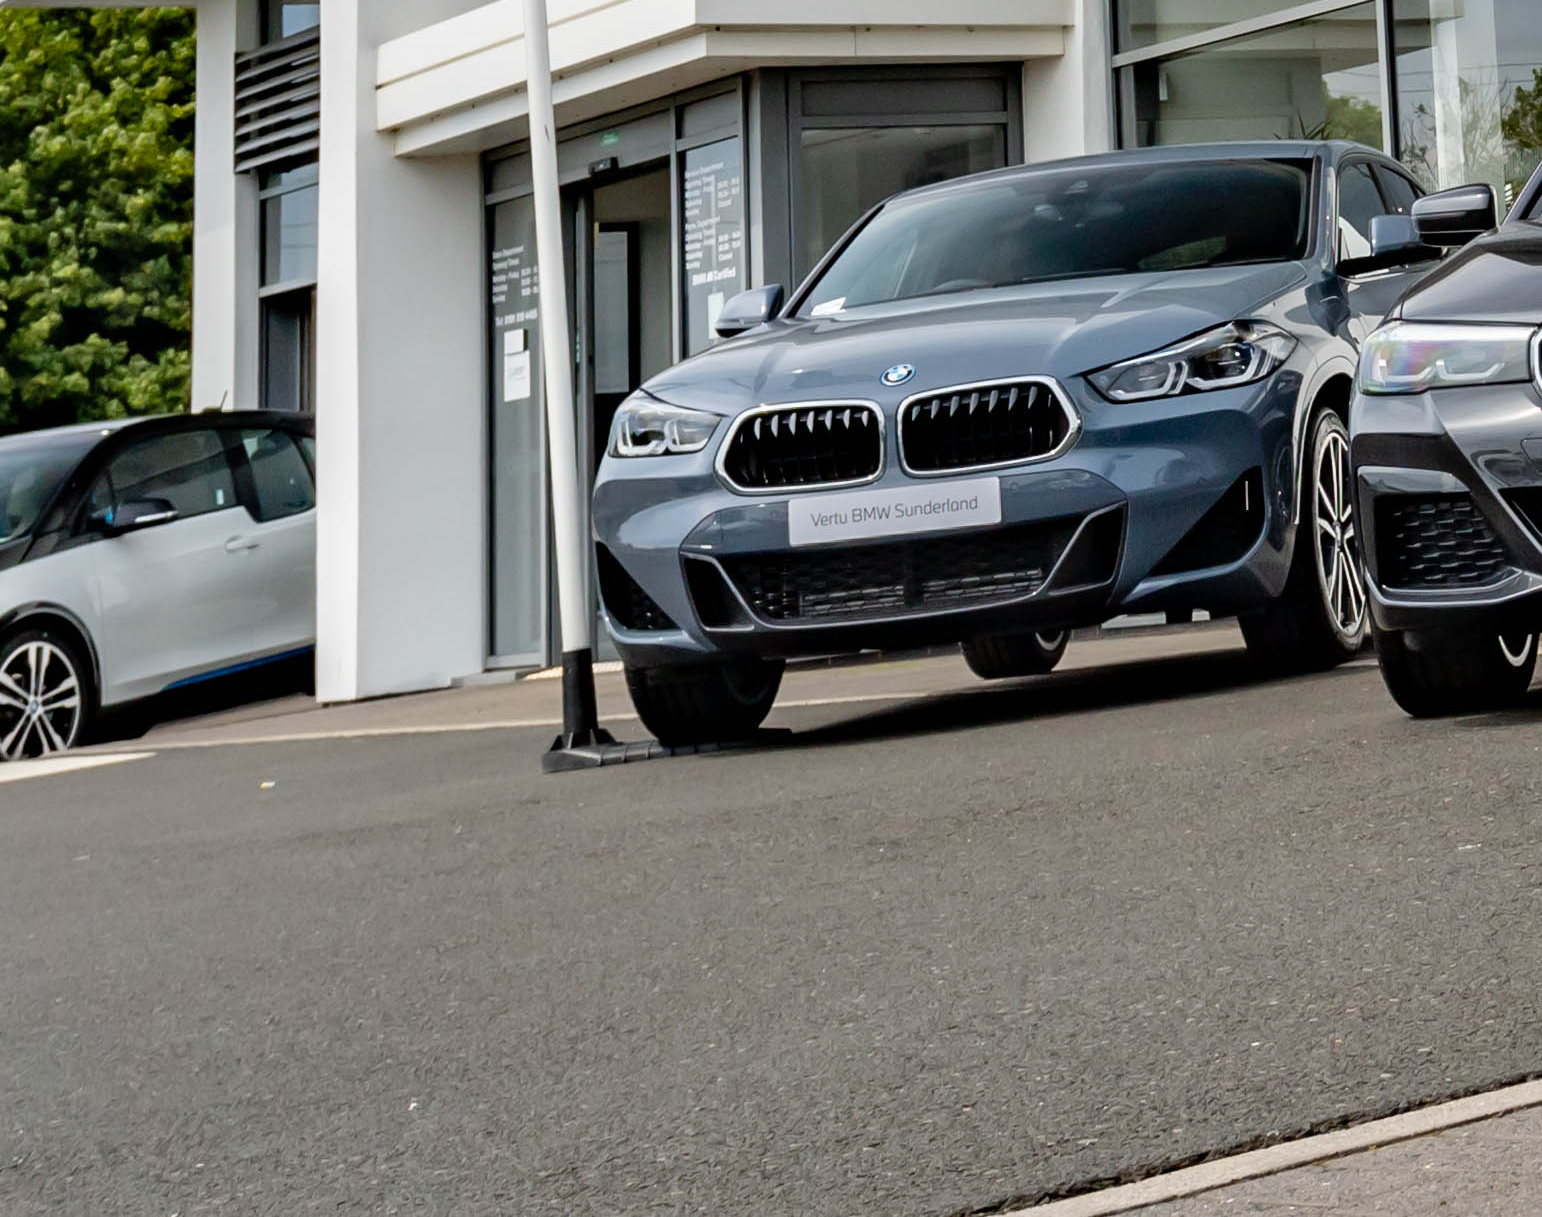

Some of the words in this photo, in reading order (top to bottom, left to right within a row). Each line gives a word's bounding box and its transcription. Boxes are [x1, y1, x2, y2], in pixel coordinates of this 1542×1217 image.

[810, 511, 848, 527] Vertu
[851, 504, 891, 522] BMW
[894, 495, 978, 518] Sunderland
